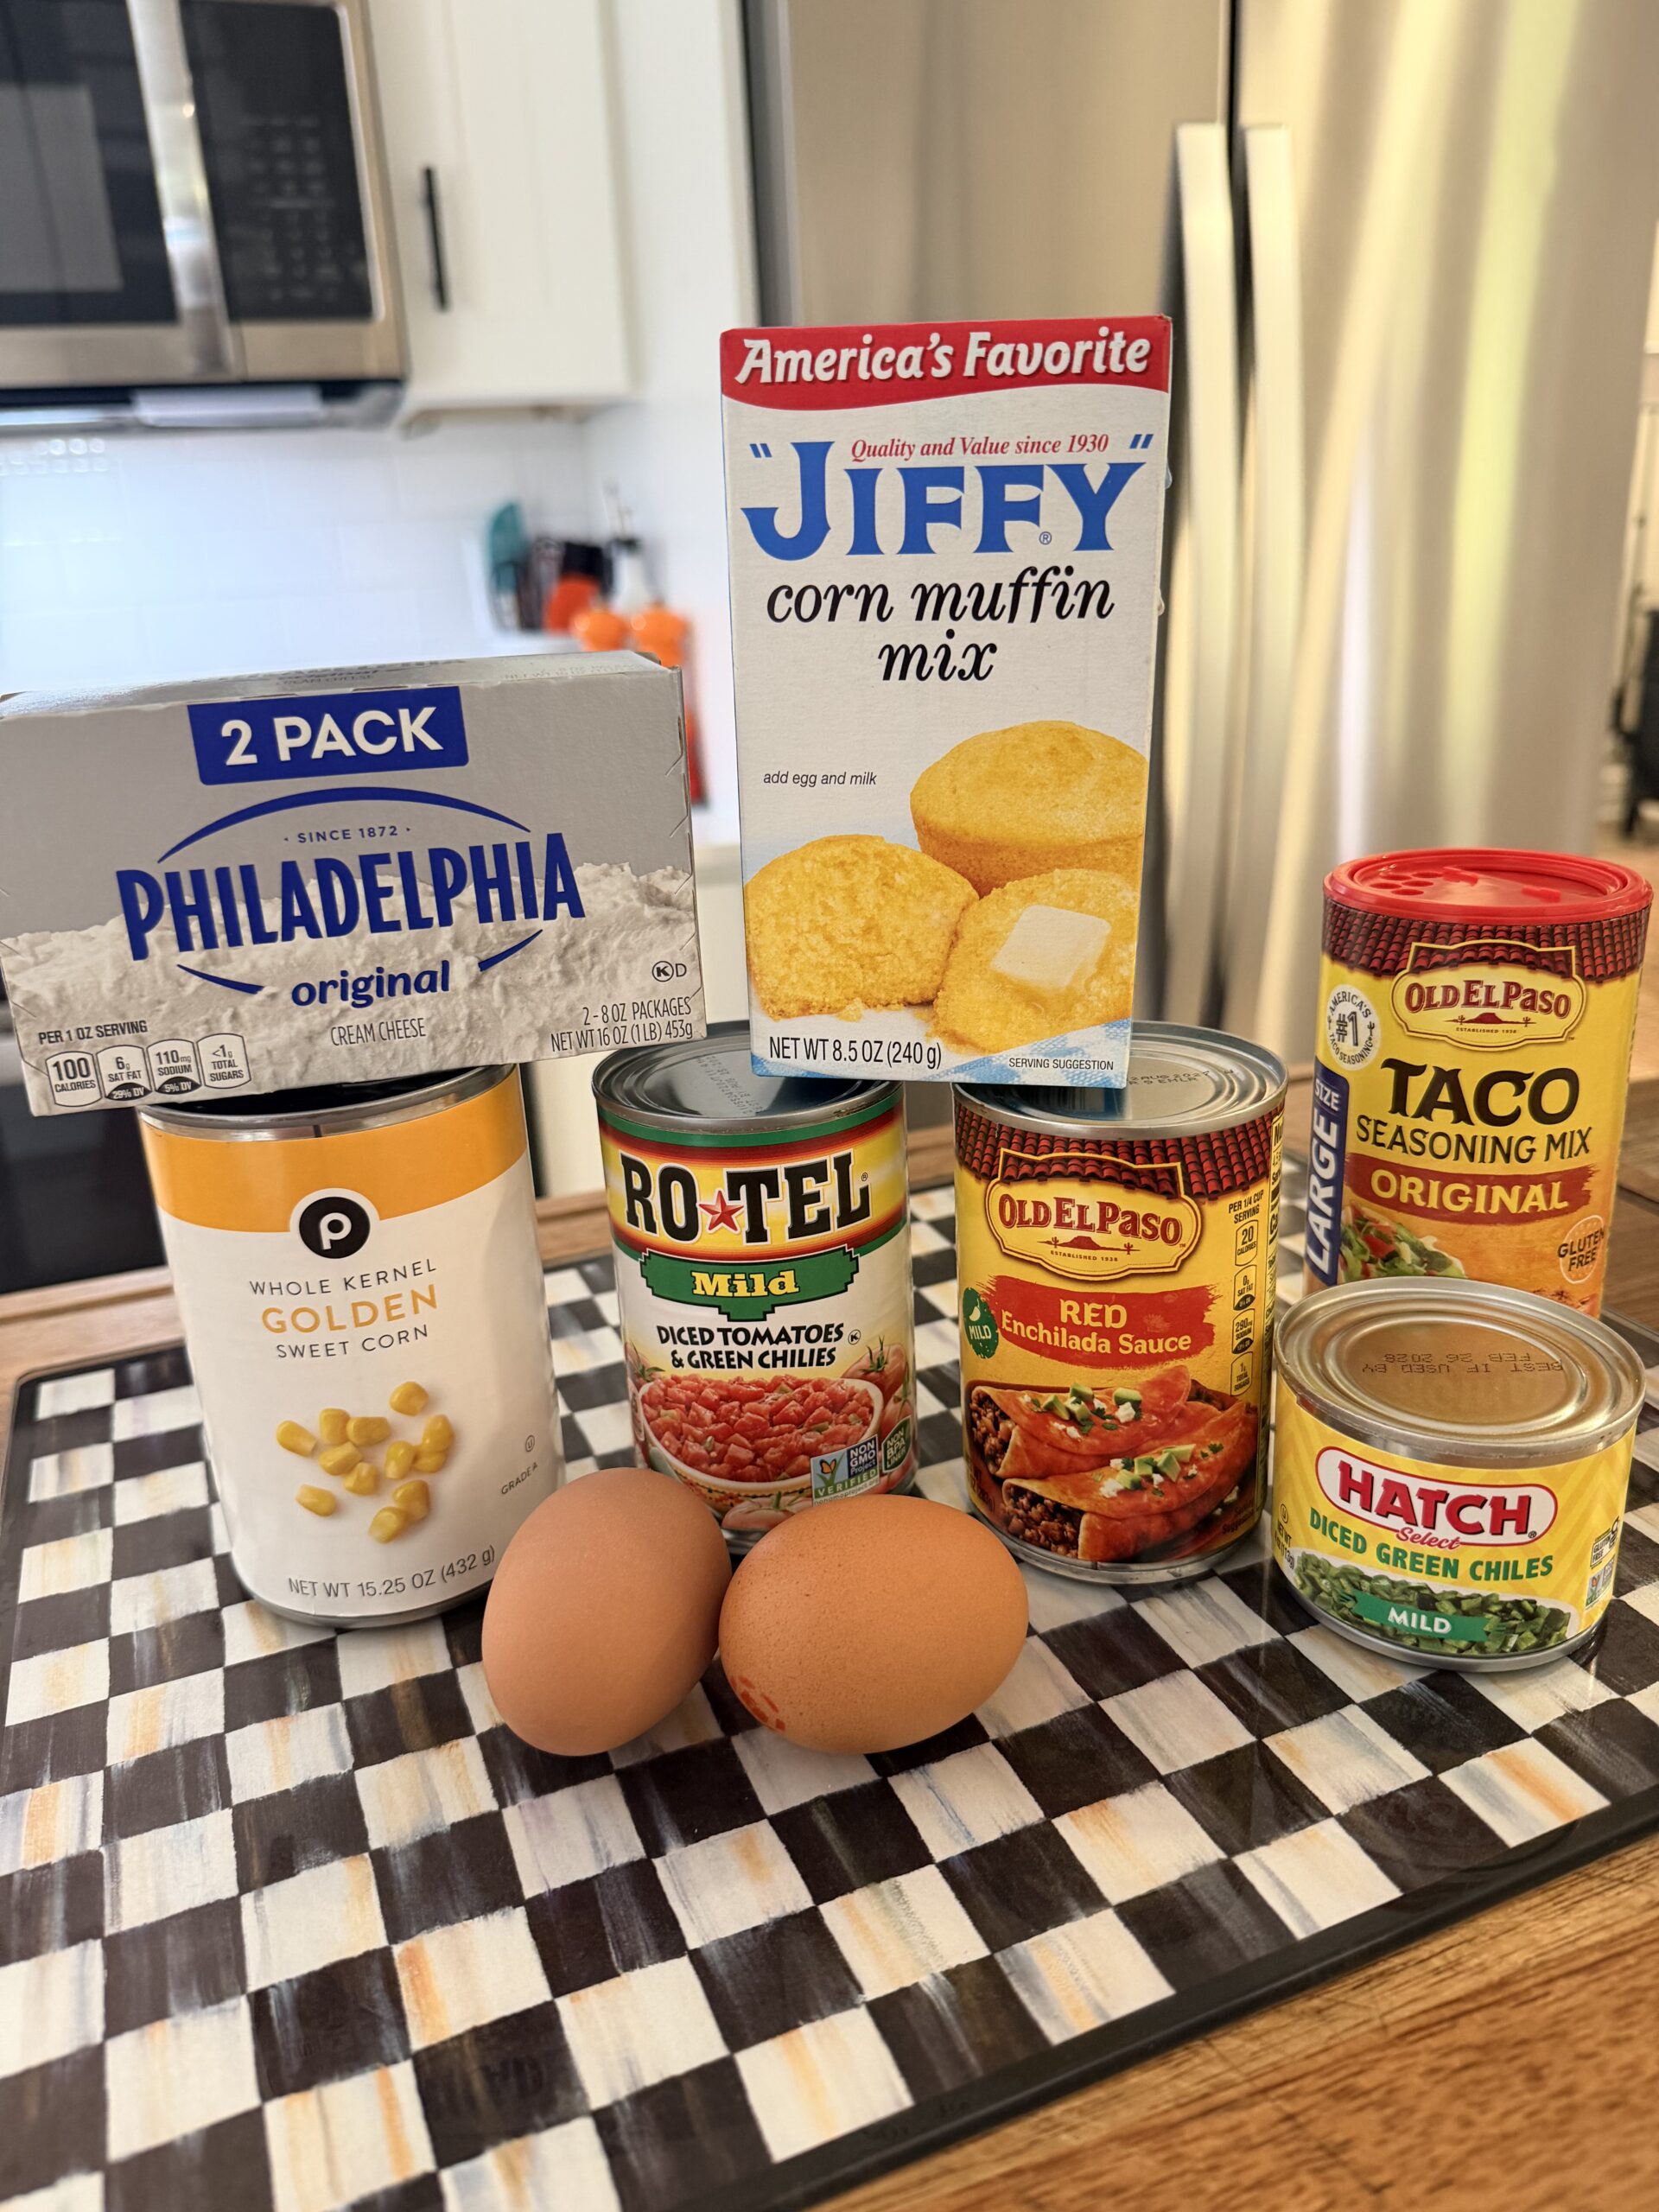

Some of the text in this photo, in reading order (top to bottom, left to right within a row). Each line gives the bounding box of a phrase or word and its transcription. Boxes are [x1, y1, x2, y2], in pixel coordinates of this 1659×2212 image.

[734, 326, 1152, 384] America's Favorite
[851, 433, 1109, 462] Quality and Value since 1930
[767, 565, 1115, 624] corn muffin
[877, 628, 998, 682] mix
[221, 706, 443, 766] 2 PACK
[763, 771, 877, 788] add egg and milk
[298, 826, 398, 843] SINCE 1872
[116, 832, 585, 962] PHILADELPHIA
[291, 960, 450, 1008] original
[1405, 982, 1460, 1013] OLD
[1462, 979, 1497, 1007] EL
[582, 1007, 589, 1026] 2
[601, 1005, 609, 1022] 8
[612, 1003, 626, 1022] OZ
[632, 996, 691, 1020] PACKAGES
[1330, 991, 1371, 1018] AMERICA'S
[38, 1020, 148, 1045] PER 1 OZ SERVING
[331, 1018, 426, 1046] CREAM CHEESE
[551, 1033, 574, 1052] NET
[575, 1030, 594, 1049] WT
[597, 1028, 611, 1046] 16
[613, 1026, 629, 1045] OZ
[664, 1020, 692, 1039] 453g
[1336, 1011, 1358, 1046] #1
[769, 1036, 942, 1070] NET WT 8.5 OZ (240 g)
[1330, 1033, 1373, 1065] TACO SEASONING
[52, 1057, 92, 1082] 100
[108, 1070, 142, 1083] SAT FAT
[157, 1064, 193, 1077] SODIUM
[209, 1070, 244, 1082] SUGARS
[211, 1059, 238, 1071] TOTAL
[1008, 1057, 1114, 1071] SERVING SUGGESTION
[54, 1080, 97, 1093] CALORIES
[133, 1086, 145, 1096] DV
[181, 1081, 192, 1091] DV
[1315, 1077, 1340, 1111] SIZE
[1381, 1058, 1580, 1127] TACO
[1356, 1115, 1592, 1165] SEASONING MIX
[1229, 1189, 1264, 1213] PER 1/4 CUP
[1306, 1107, 1338, 1275] LARGE
[1370, 1169, 1569, 1214] ORIGINAL
[998, 1193, 1052, 1229] OLD
[1054, 1197, 1095, 1234] EL
[1234, 1204, 1260, 1224] SERVING
[1237, 1241, 1256, 1255] CALORIES
[1242, 1225, 1254, 1245] 20
[1557, 1227, 1605, 1259] GLUTEN
[1051, 1249, 1097, 1262] ESTABLISHED
[1568, 1247, 1598, 1272] FREE
[249, 1258, 437, 1296] WHOLE KERNEL
[691, 1269, 799, 1298] Mild
[261, 1284, 438, 1334] GOLDEN
[1059, 1299, 1128, 1329] RED
[276, 1324, 429, 1359] SWEET CORN
[657, 1323, 844, 1346] DICED TOMATOES
[968, 1324, 992, 1340] MILD
[1001, 1309, 1192, 1355] Enchilada Sauce
[671, 1347, 836, 1369] & GREEN CHILIES
[1362, 1361, 1564, 1374] BEST IF USED BY
[1383, 1353, 1530, 1363] FEB 26 2028
[850, 1440, 875, 1459] NON
[887, 1427, 904, 1448] NON
[887, 1438, 906, 1459] BPA
[850, 1450, 876, 1467] GMO
[500, 1468, 531, 1496] GRADE
[817, 1469, 877, 1497] VERIFIED
[1337, 1460, 1532, 1535] HATCH
[1308, 1507, 1367, 1554] DICED
[1376, 1543, 1459, 1579] GREEN
[1469, 1554, 1554, 1581] CHILES
[1395, 1527, 1460, 1551] Select
[288, 1544, 497, 1598] NET WT 15.25 OZ (432 g)
[1387, 1606, 1451, 1634] MILD
